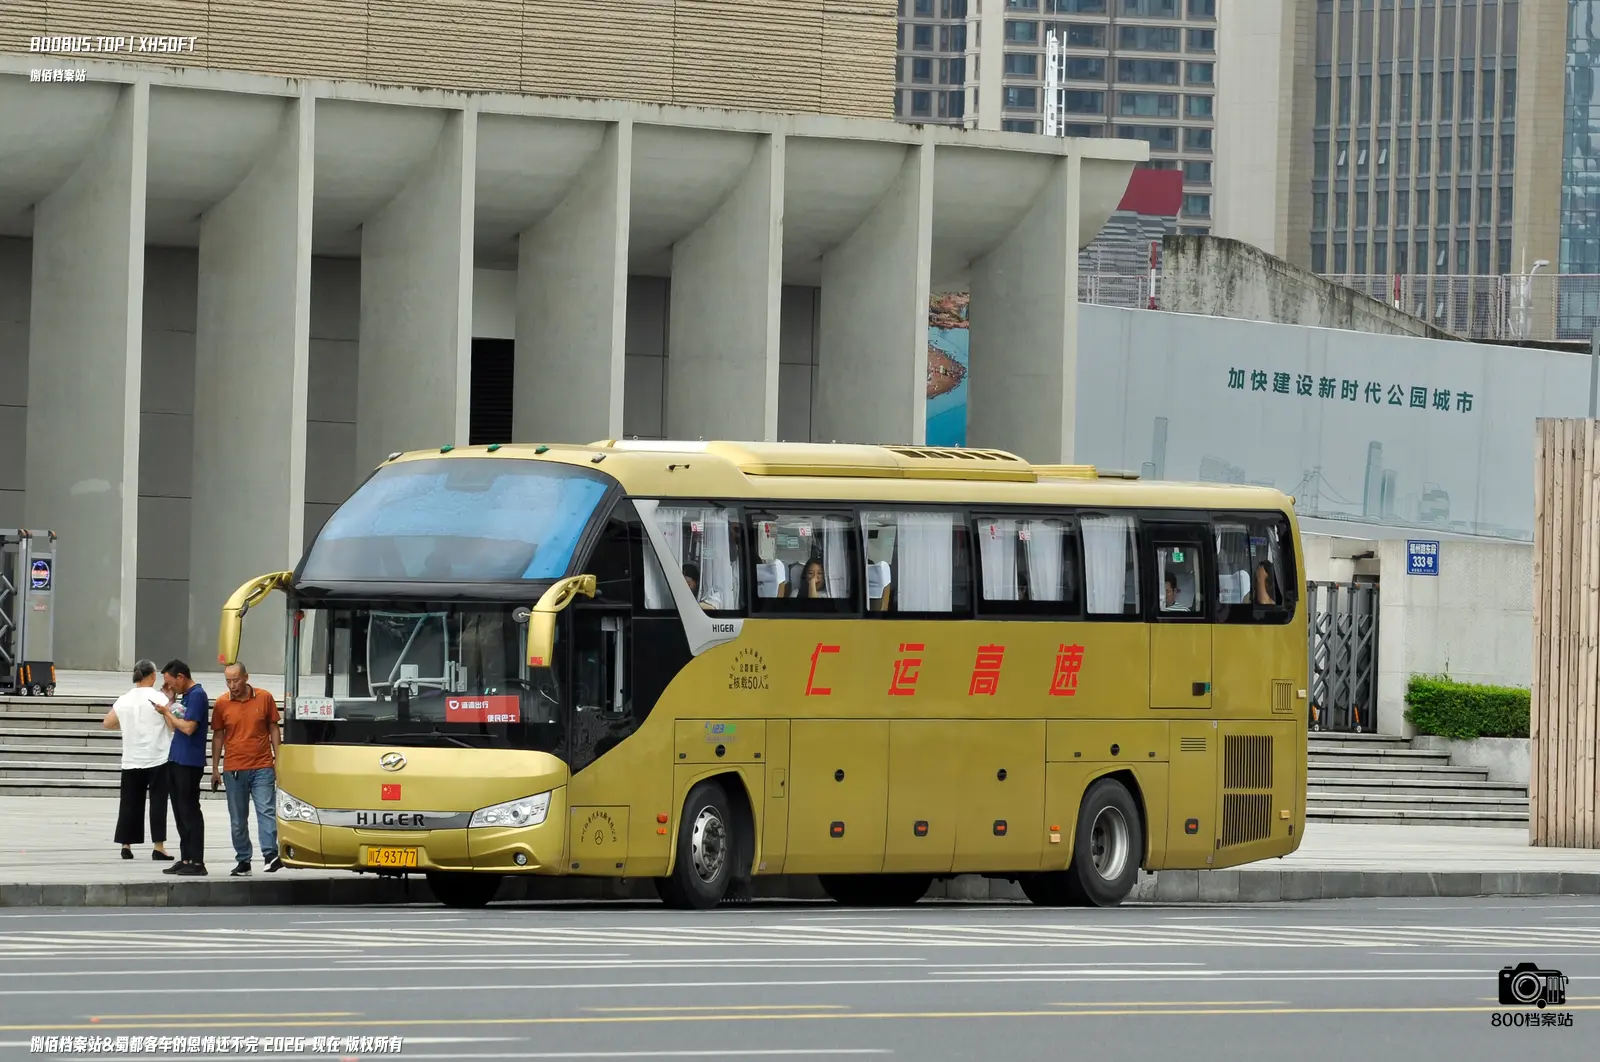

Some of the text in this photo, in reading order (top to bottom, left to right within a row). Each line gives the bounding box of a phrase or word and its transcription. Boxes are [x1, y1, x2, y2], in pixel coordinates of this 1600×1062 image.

[1227, 367, 1474, 414] 加快建设新时代公园城市
[712, 624, 735, 633] HIGER
[805, 643, 1084, 696] 仁运高速
[357, 812, 425, 826] HIGER
